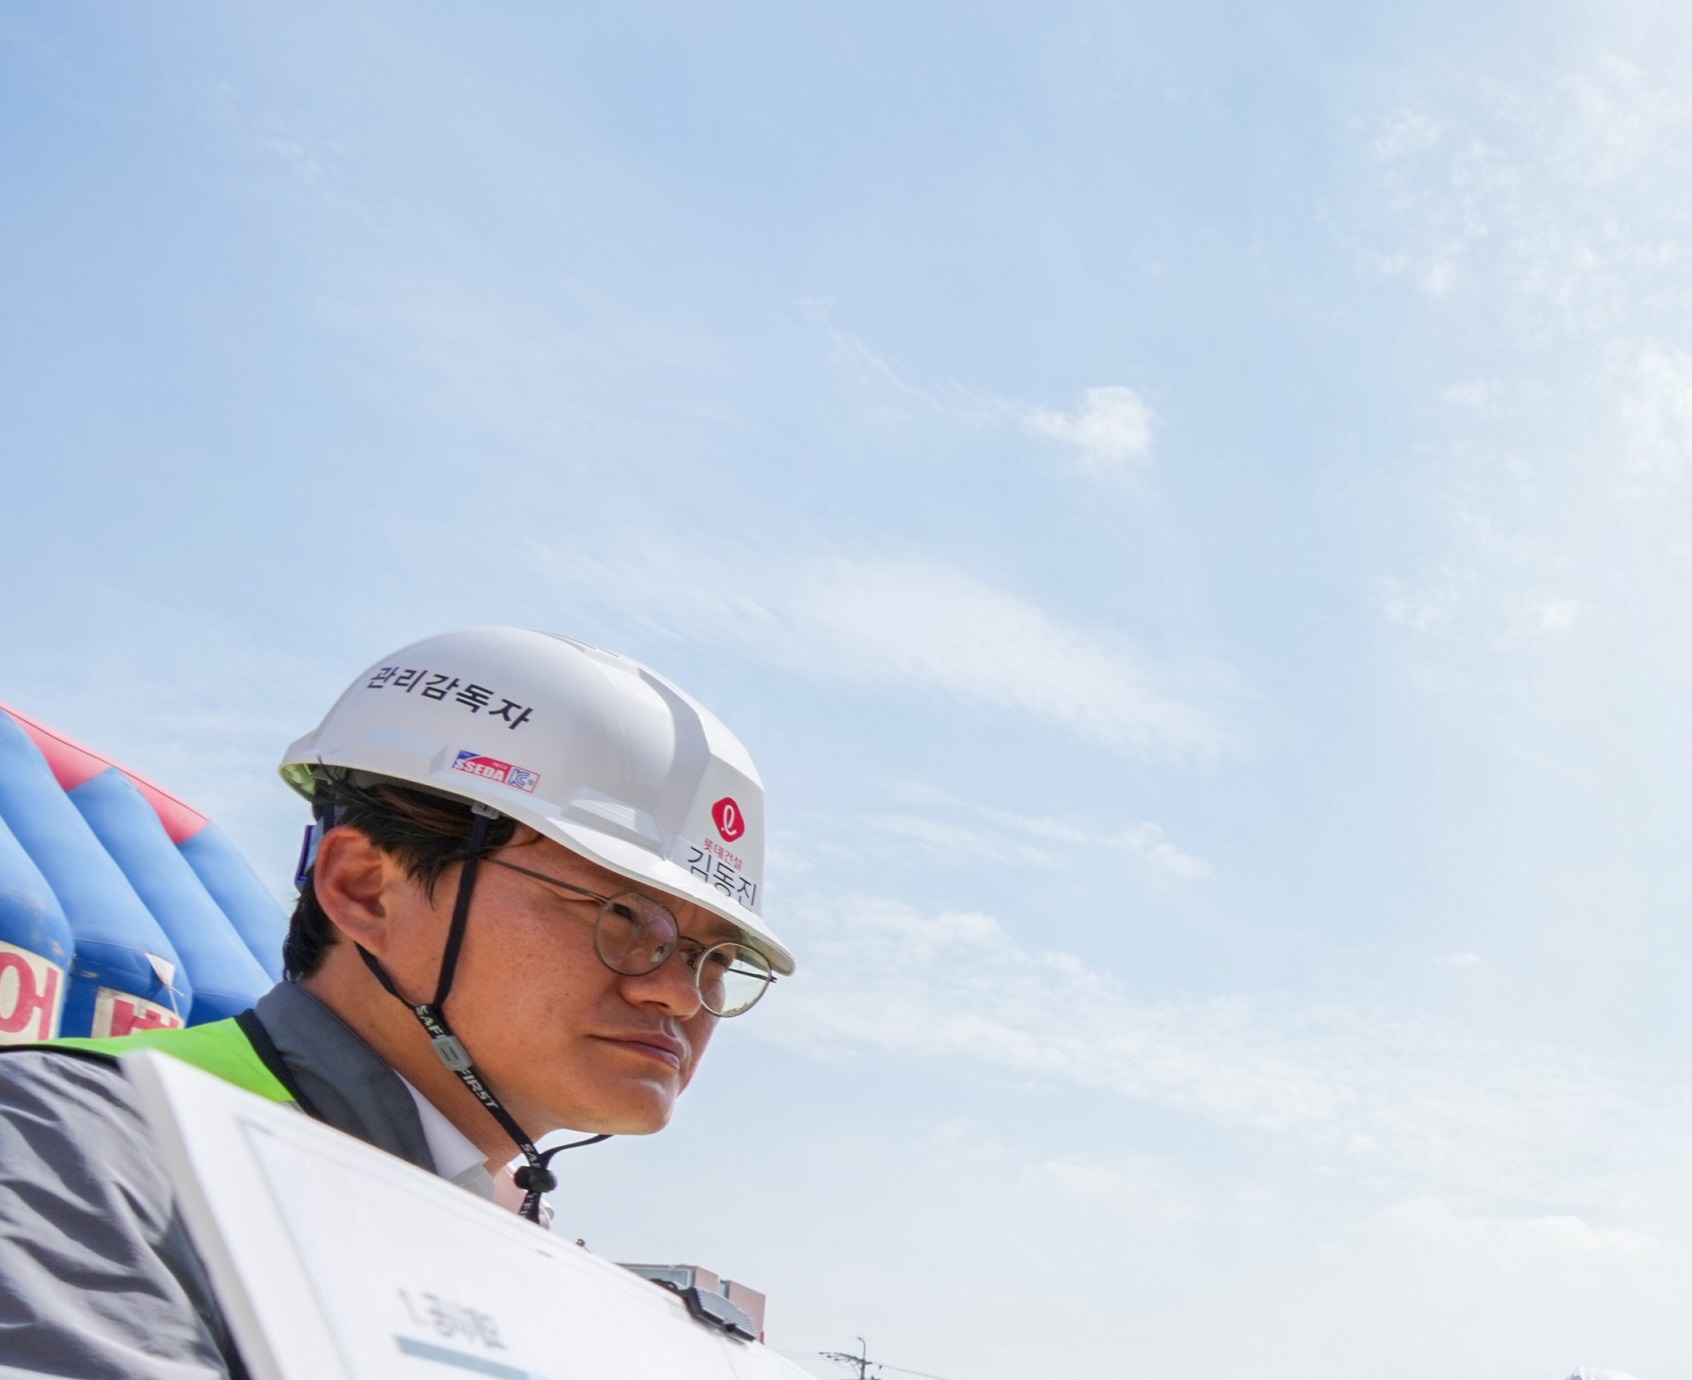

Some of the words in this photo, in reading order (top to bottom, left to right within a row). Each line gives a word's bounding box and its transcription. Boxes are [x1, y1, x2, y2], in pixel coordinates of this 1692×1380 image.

[367, 666, 533, 730] 관리감독자
[703, 838, 743, 871] 롯데건설
[416, 1005, 447, 1039] SAF
